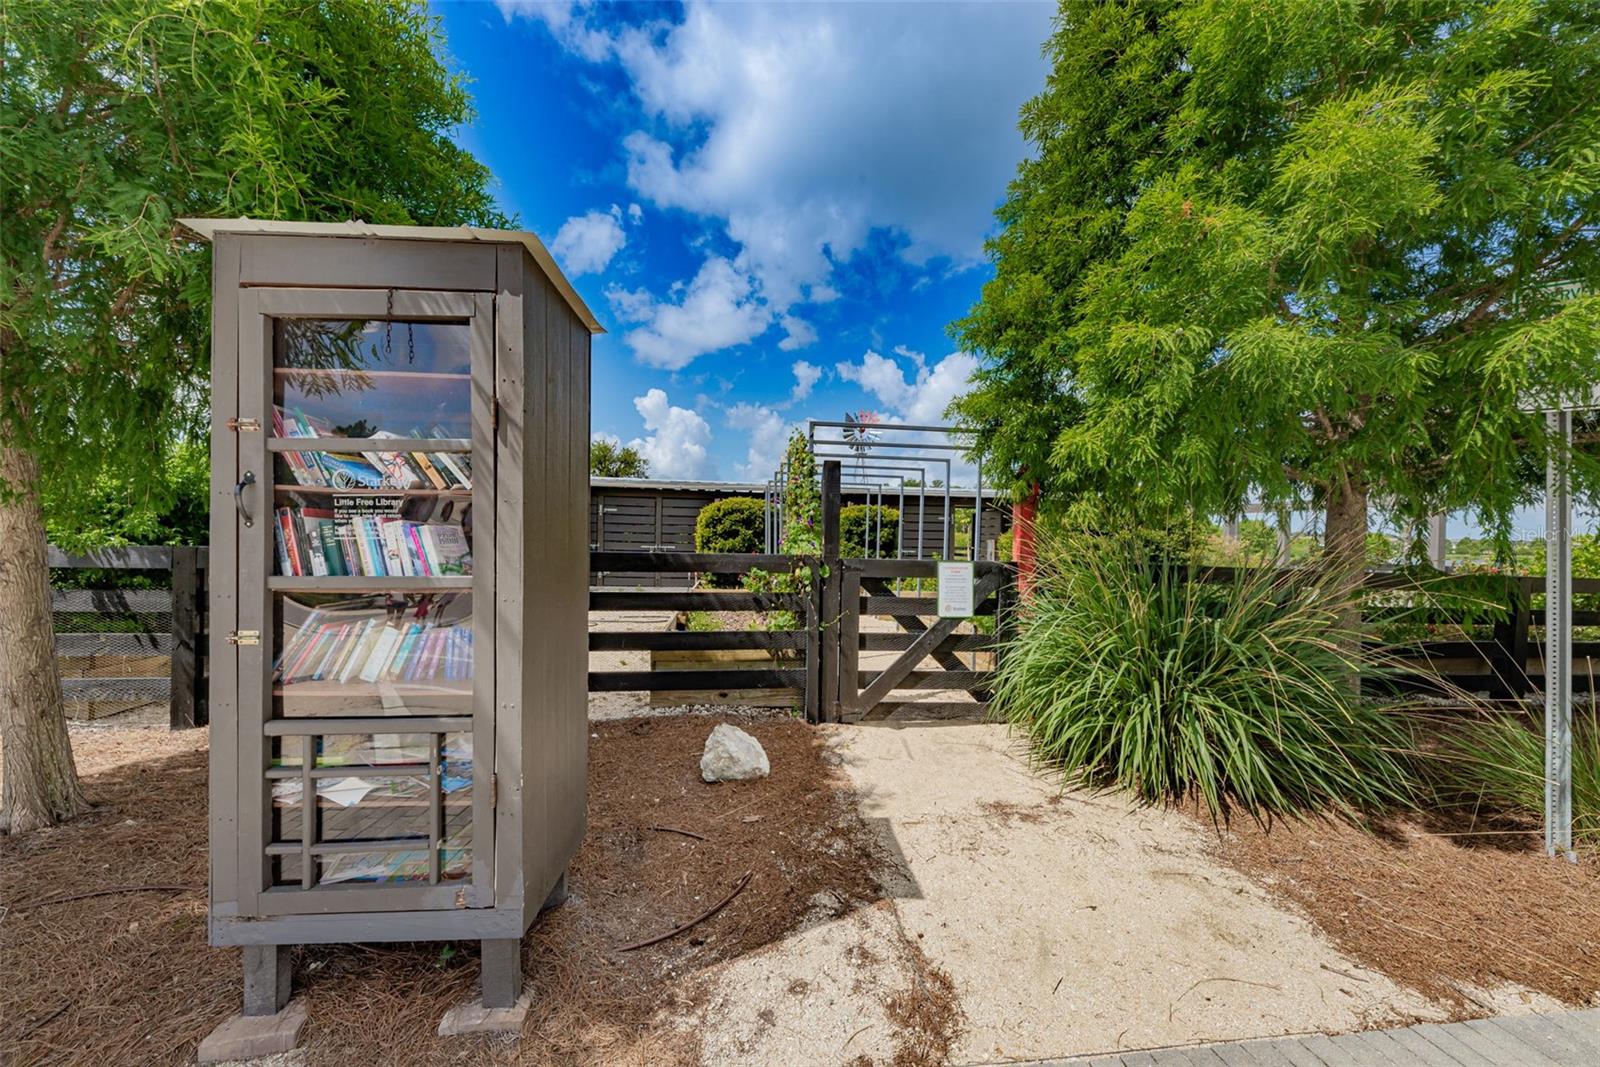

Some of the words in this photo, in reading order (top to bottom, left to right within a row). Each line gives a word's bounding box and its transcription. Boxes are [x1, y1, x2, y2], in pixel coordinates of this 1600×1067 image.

[357, 473, 402, 488] Starke
[334, 498, 354, 506] Little
[356, 498, 374, 506] Free
[375, 498, 404, 509] Library
